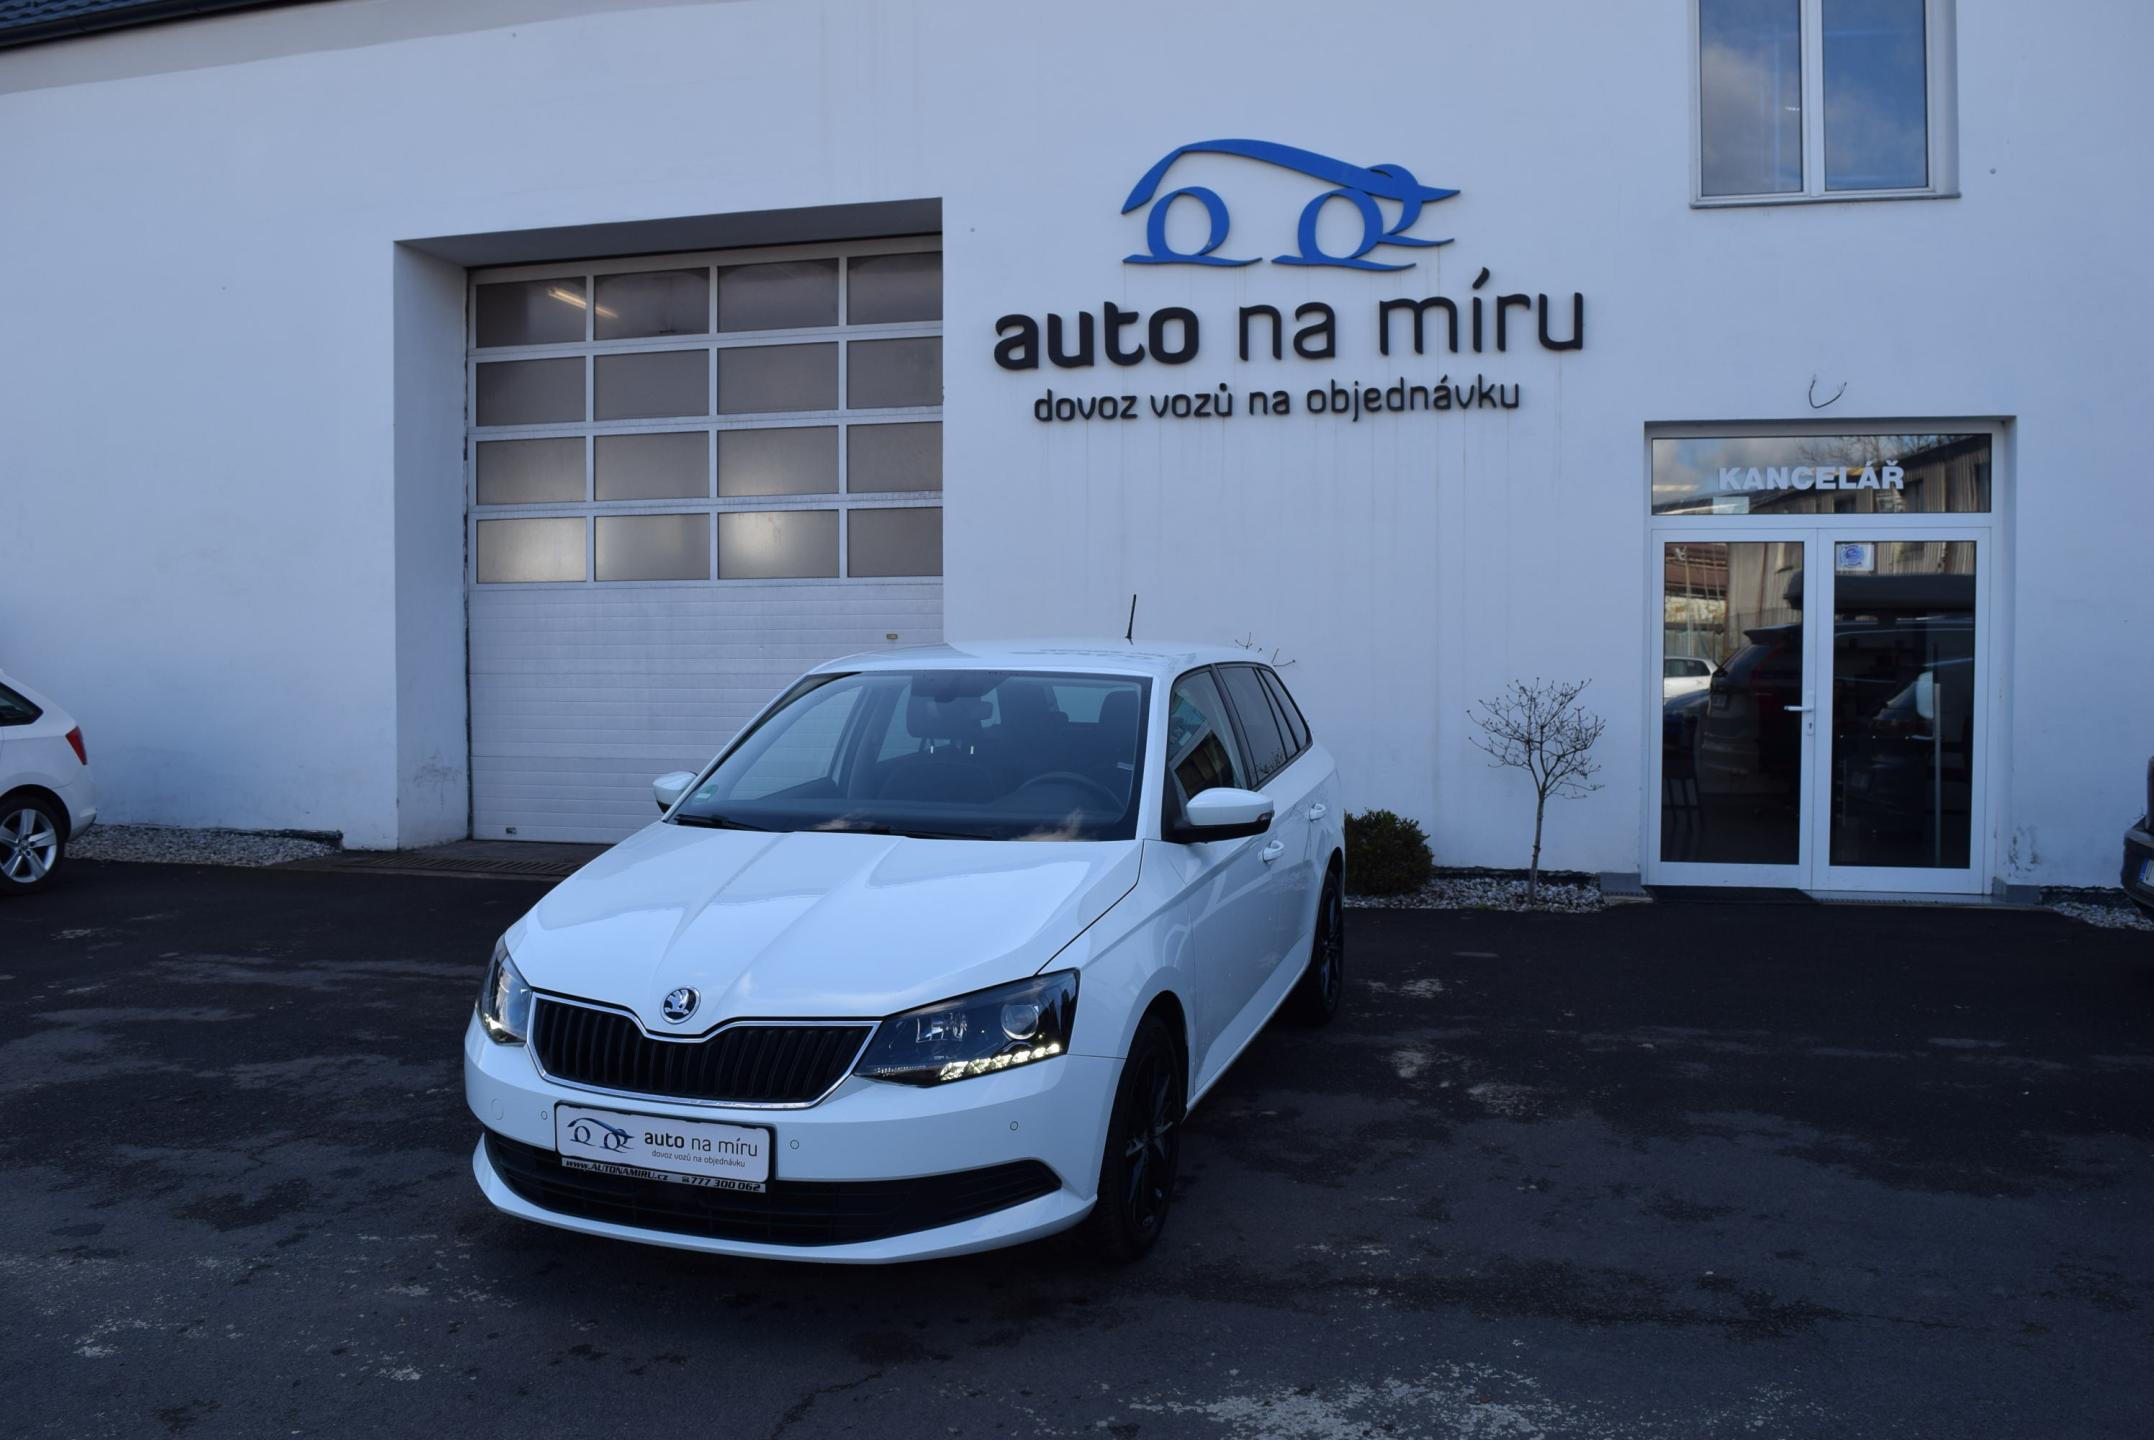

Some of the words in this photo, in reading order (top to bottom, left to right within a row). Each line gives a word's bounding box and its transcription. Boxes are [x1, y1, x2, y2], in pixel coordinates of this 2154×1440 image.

[993, 301, 1200, 371] auto
[1239, 302, 1336, 362] na
[1379, 267, 1584, 356] míru
[1034, 388, 1139, 422] dovoz
[1150, 383, 1233, 419] vozů
[1249, 388, 1290, 416] na
[1306, 374, 1520, 422] objednávku
[1718, 460, 1905, 491] KANCELÁŘ
[644, 1132, 685, 1149] auto
[691, 1137, 711, 1152] na
[718, 1137, 758, 1157] míru
[651, 1149, 673, 1159] dovoz
[674, 1152, 692, 1161] vozů
[693, 1155, 702, 1163] na
[704, 1155, 746, 1168] objednávku
[691, 1176, 712, 1186] 777
[714, 1180, 736, 1189] 300
[738, 1183, 761, 1192] 062
